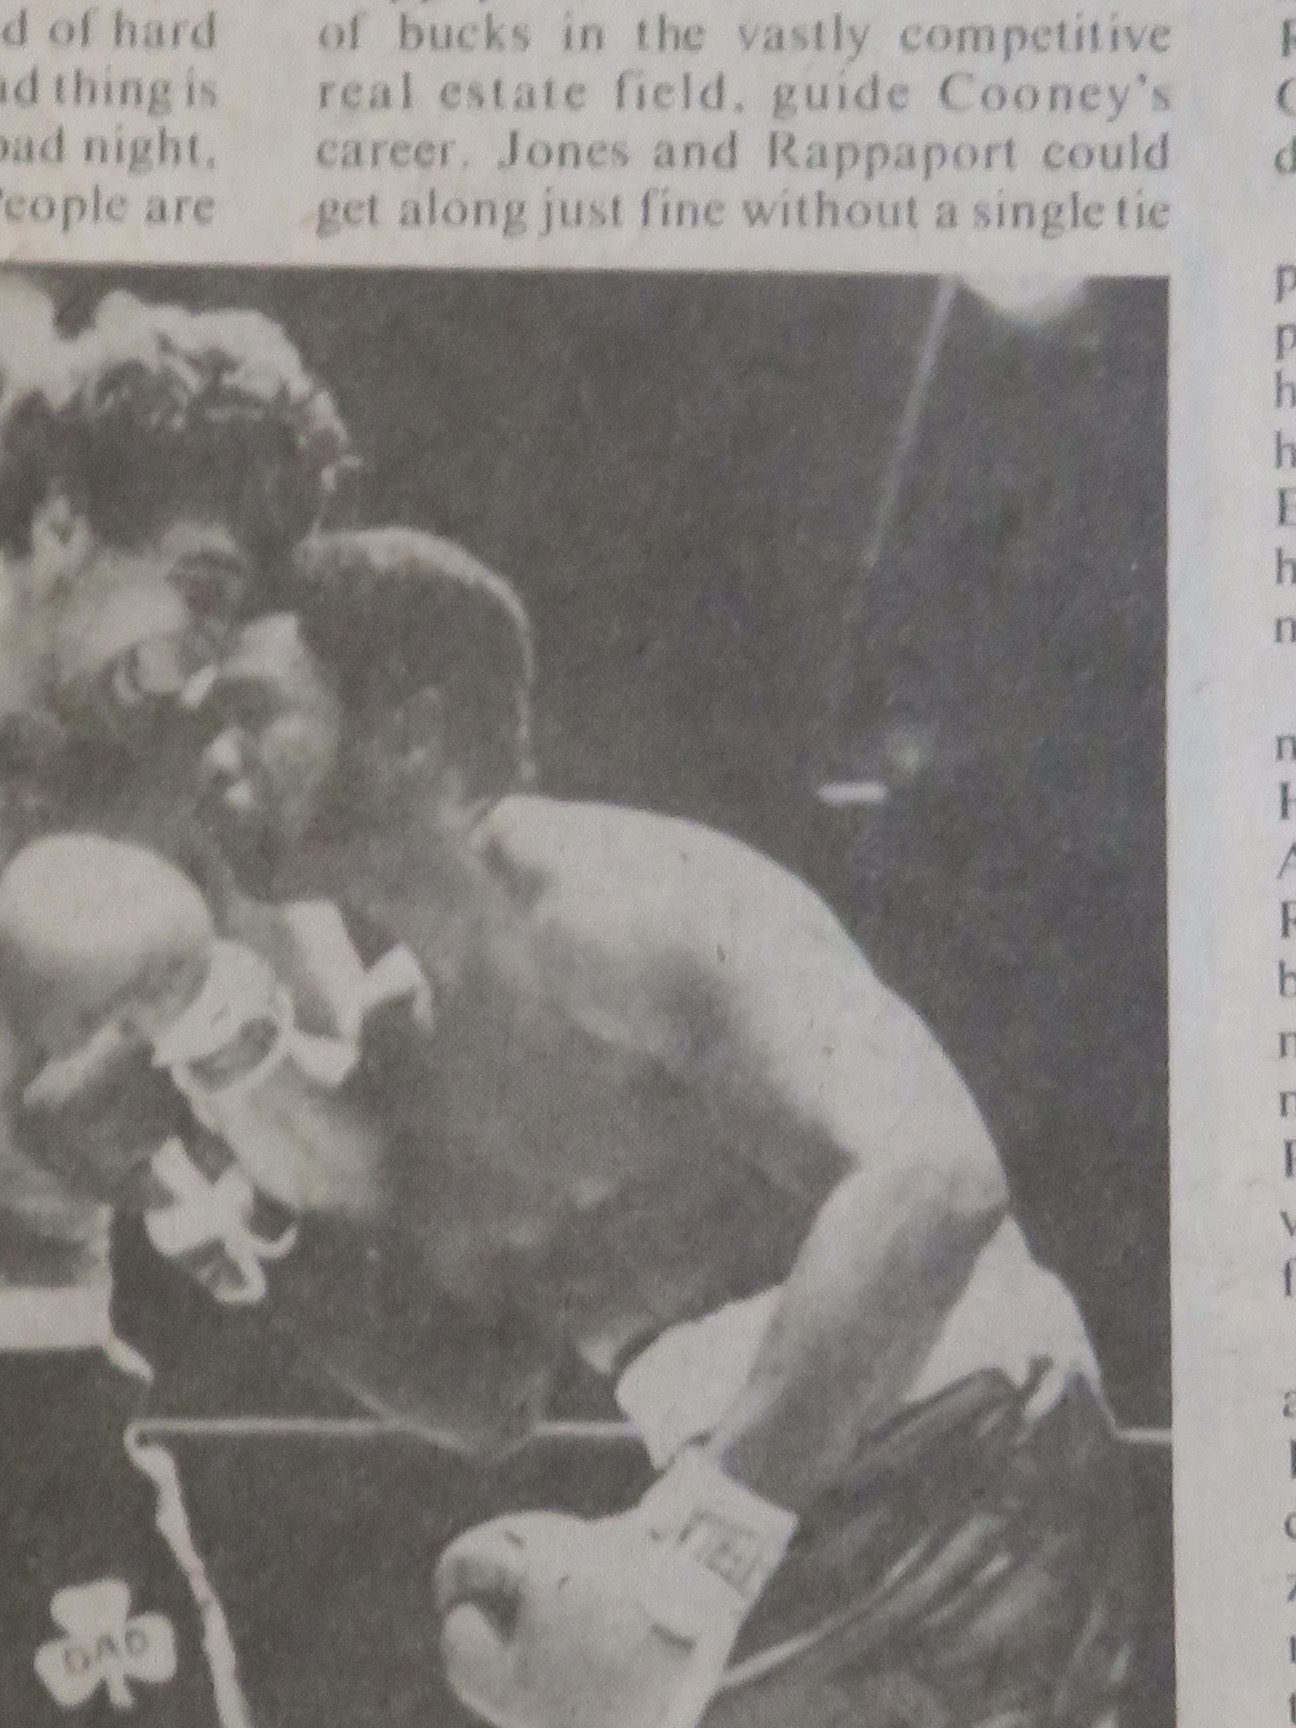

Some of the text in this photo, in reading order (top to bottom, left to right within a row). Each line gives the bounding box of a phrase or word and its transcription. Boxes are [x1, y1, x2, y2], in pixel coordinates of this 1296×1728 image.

[315, 9, 1174, 66] of bucks in the vastly competitive
[316, 67, 1174, 126] real estate field, guide Cooney's
